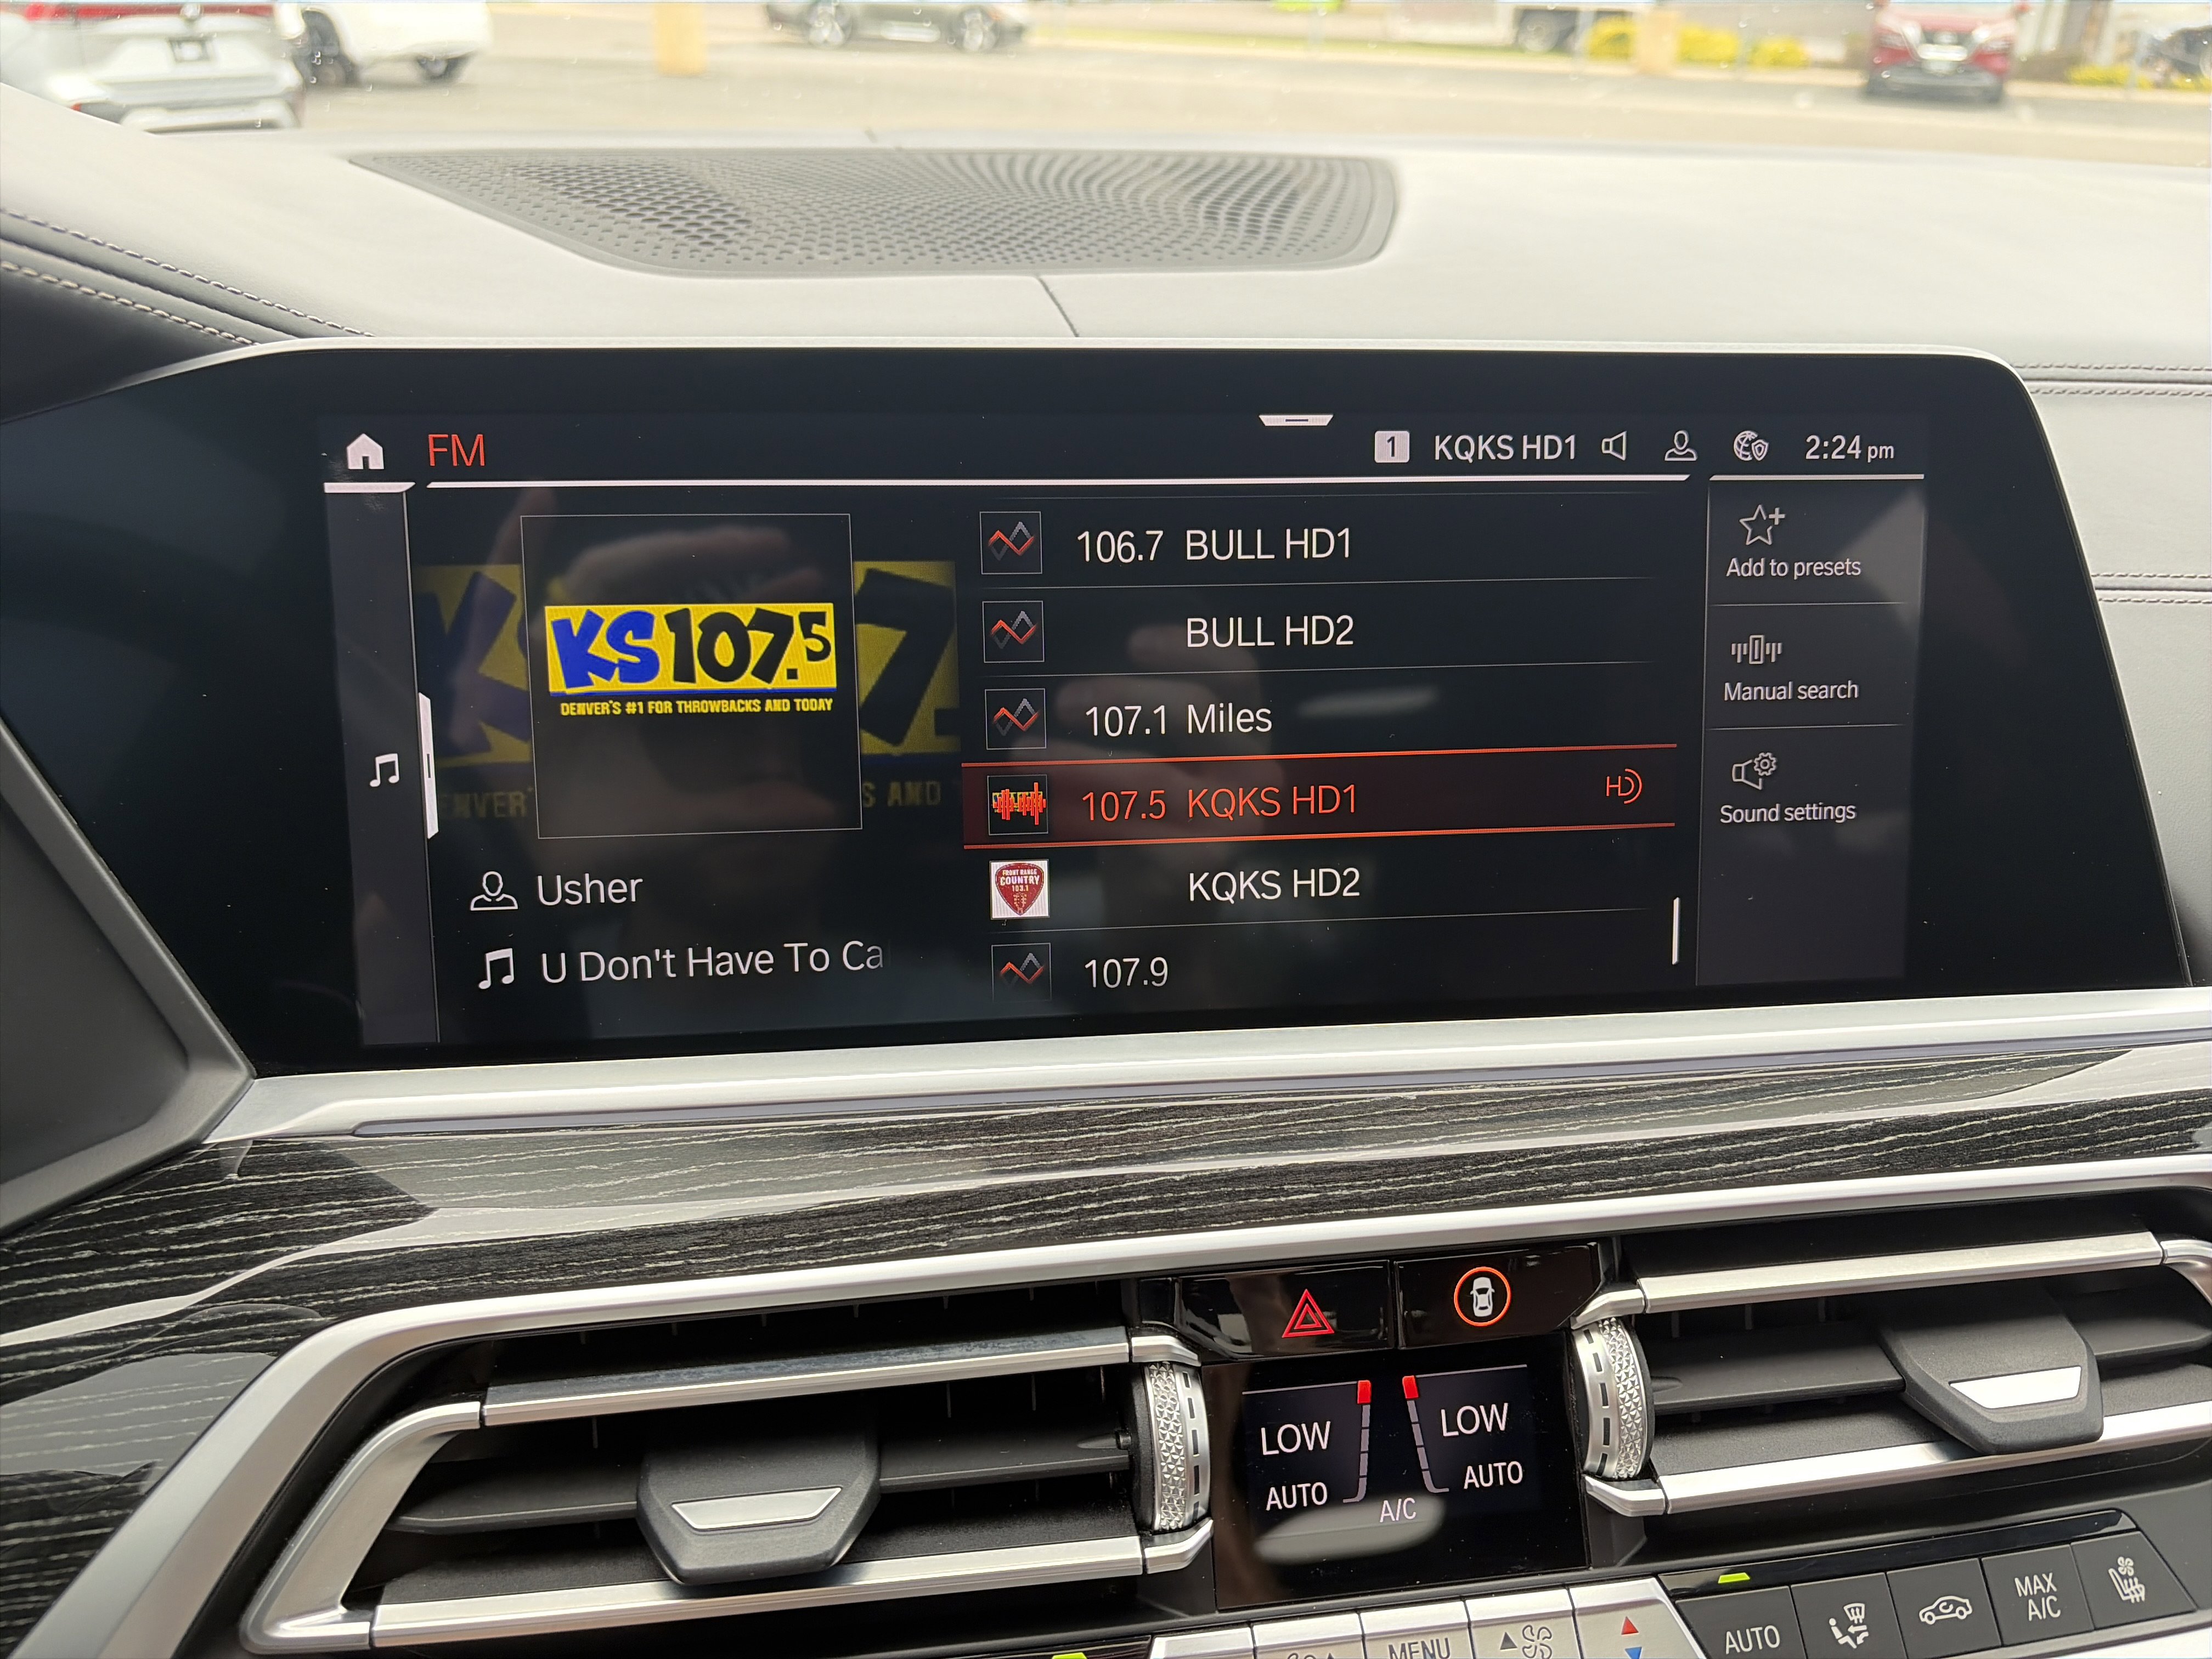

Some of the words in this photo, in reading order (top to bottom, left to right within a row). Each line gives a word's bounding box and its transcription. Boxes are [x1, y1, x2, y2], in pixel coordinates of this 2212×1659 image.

[428, 434, 485, 466] FM
[1435, 435, 1514, 462] KQKS
[1522, 435, 1576, 460] HD1
[1805, 435, 1861, 459] 2:24
[1867, 445, 1894, 464] pm
[1077, 530, 1164, 563] 106.7
[1186, 529, 1275, 560] BULL
[1286, 528, 1351, 559] HD1
[1726, 557, 1764, 577] Add
[1769, 558, 1788, 577] to
[1794, 557, 1861, 580] presets
[1187, 617, 1275, 647] BULL
[1286, 614, 1353, 646] HD2
[1724, 681, 1792, 701] Manual
[1797, 680, 1859, 699] search
[560, 700, 622, 716] DENVER'S
[625, 701, 644, 715] #1
[647, 701, 673, 714] FOR
[676, 699, 761, 714] THROWBACKS
[765, 698, 789, 713] AND
[793, 698, 833, 712] TODAY
[1086, 705, 1165, 737] 107.1
[1188, 702, 1272, 733] Miles
[1082, 790, 1166, 821] 107.5
[1188, 787, 1280, 821] KQKS
[1293, 785, 1356, 815] HD1
[1720, 803, 1780, 824] Sound
[1784, 802, 1857, 823] settings
[538, 873, 643, 906] Usher
[1000, 875, 1040, 886] COUNTRY
[1189, 870, 1282, 904] KQKS
[1293, 867, 1360, 898] HD2
[542, 952, 566, 983] U
[580, 949, 676, 981] Don't
[688, 946, 774, 977] Have
[783, 943, 830, 972] To
[1085, 957, 1168, 988] 107.9
[1441, 1402, 1509, 1437] LOW
[1261, 1420, 1331, 1455] LOW
[1464, 1461, 1523, 1490] AUTO
[1266, 1482, 1328, 1511] AUTO
[1379, 1497, 1417, 1523] A/C
[2015, 1572, 2057, 1597] MAX
[2027, 1594, 2062, 1621] A/C
[1388, 1638, 1450, 1659] MENU
[1725, 1624, 1780, 1655] AUTO
